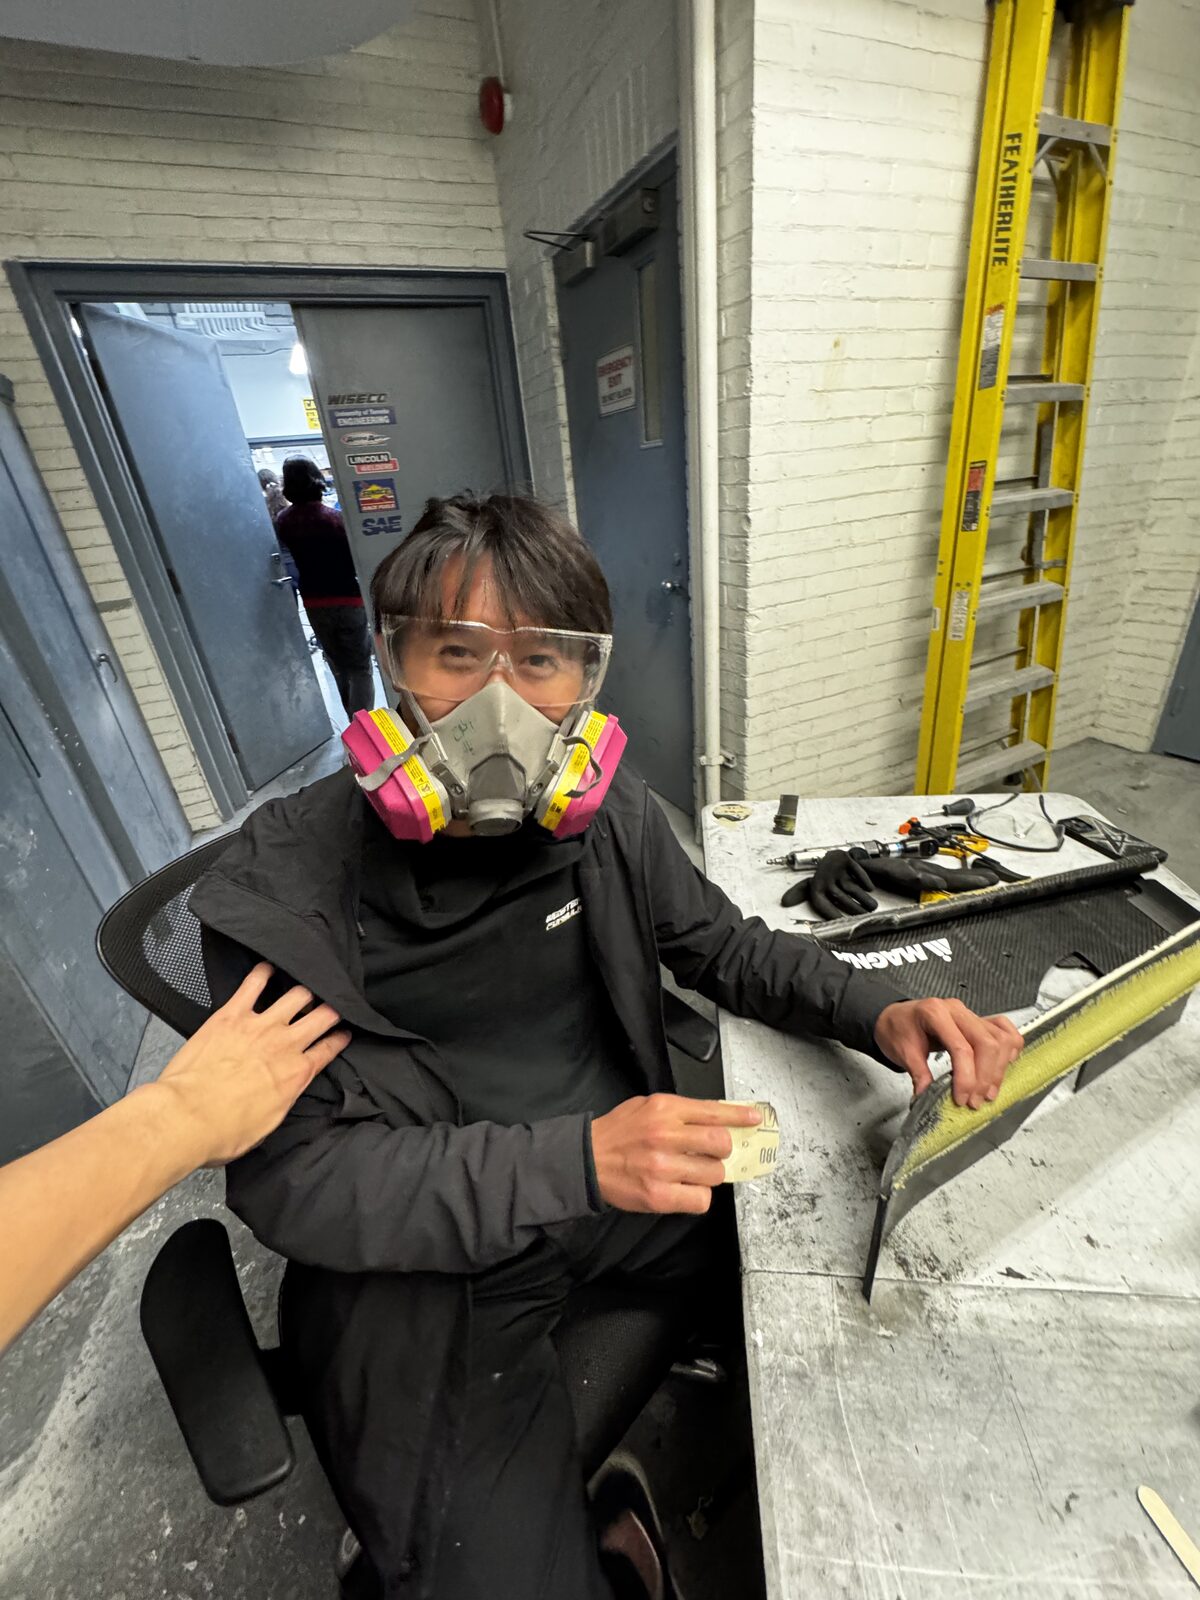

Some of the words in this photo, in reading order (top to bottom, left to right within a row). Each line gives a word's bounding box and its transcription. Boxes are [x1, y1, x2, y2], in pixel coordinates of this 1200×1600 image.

[992, 132, 1023, 267] FEATHERLITE
[597, 355, 633, 378] EMERGENCY
[607, 373, 623, 388] EXIT
[328, 393, 387, 405] WISECO
[337, 415, 389, 426] ENGINEERING
[349, 454, 388, 464] LINCOLN
[362, 515, 402, 536] SAE
[759, 1146, 777, 1164] 180
